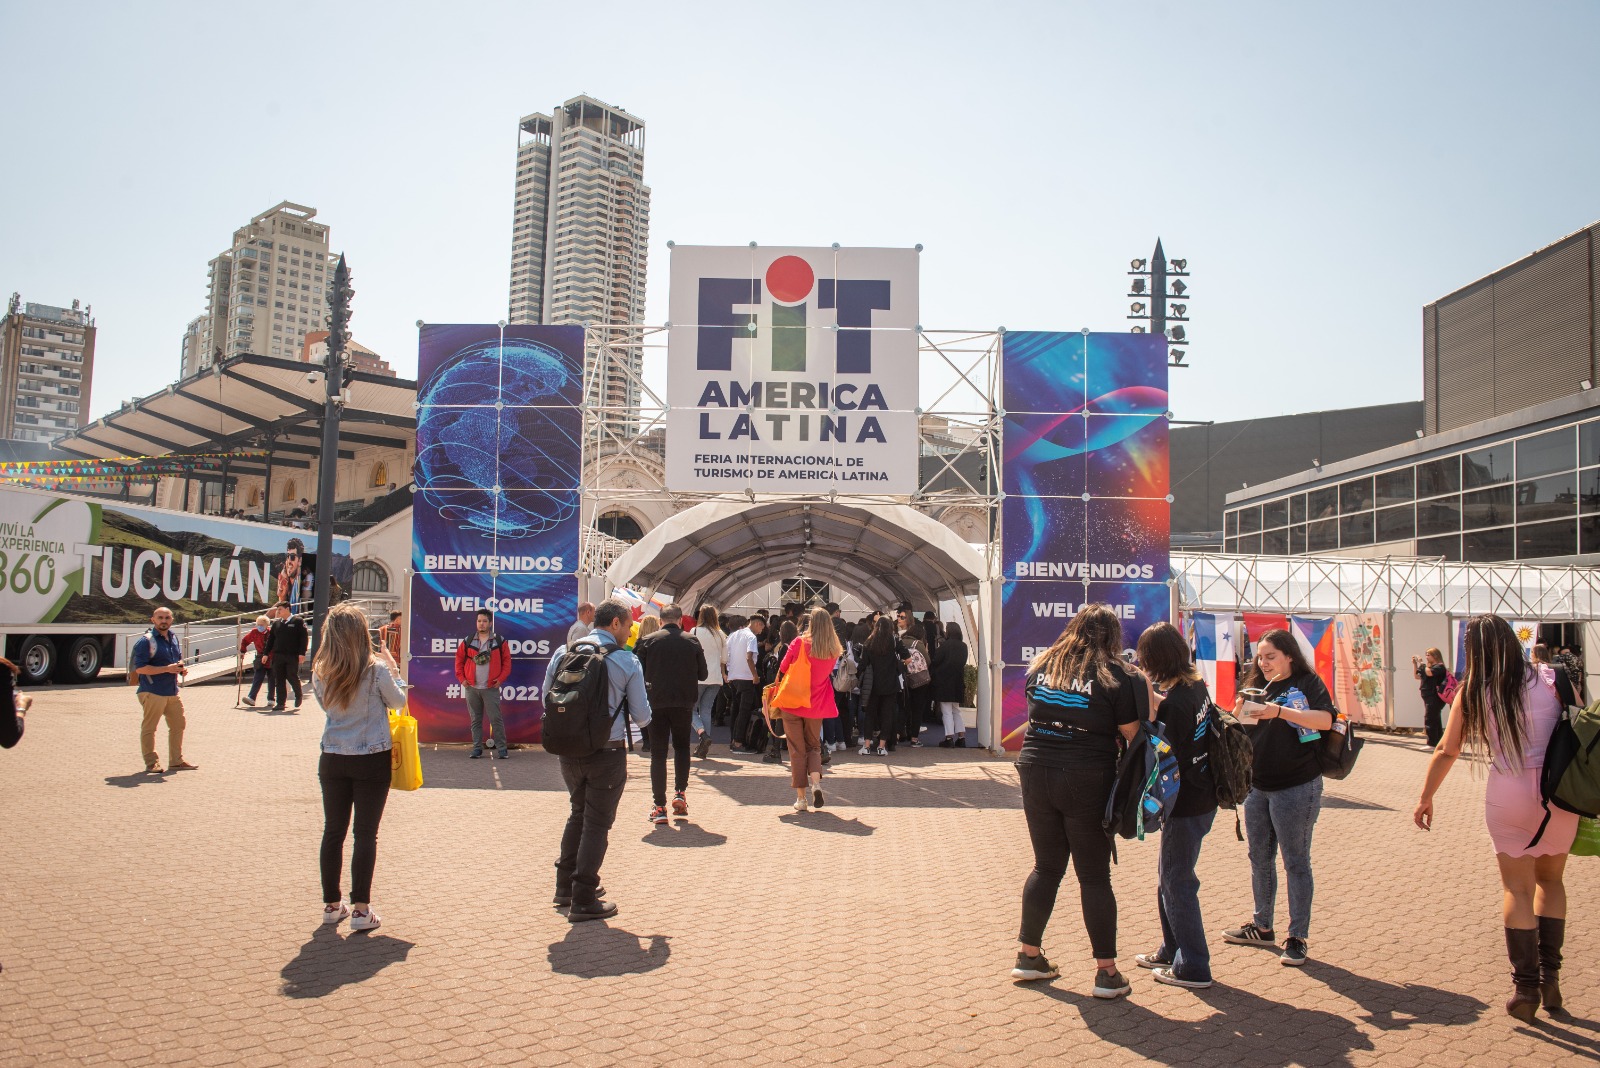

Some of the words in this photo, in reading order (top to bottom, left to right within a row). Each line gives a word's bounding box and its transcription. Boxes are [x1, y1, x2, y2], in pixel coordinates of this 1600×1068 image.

[697, 380, 889, 410] AMERICA
[699, 412, 888, 443] LATINA
[694, 453, 732, 464] FERIA
[736, 454, 842, 466] INTERNACIONAL
[846, 457, 864, 467] DE
[694, 468, 754, 478] TURISMO
[757, 469, 775, 479] DE
[778, 470, 839, 480] AMERICA
[842, 471, 889, 481] LATINA
[20, 525, 35, 538] LA
[424, 554, 563, 571] BIENVENIDOS
[1015, 561, 1154, 579] BIENVENIDOS
[74, 545, 270, 602] TUCUMÁN
[439, 596, 544, 613] WELCOME
[1031, 602, 1136, 619] WELME
[431, 638, 550, 655] BEDOS
[445, 683, 540, 701] #022
